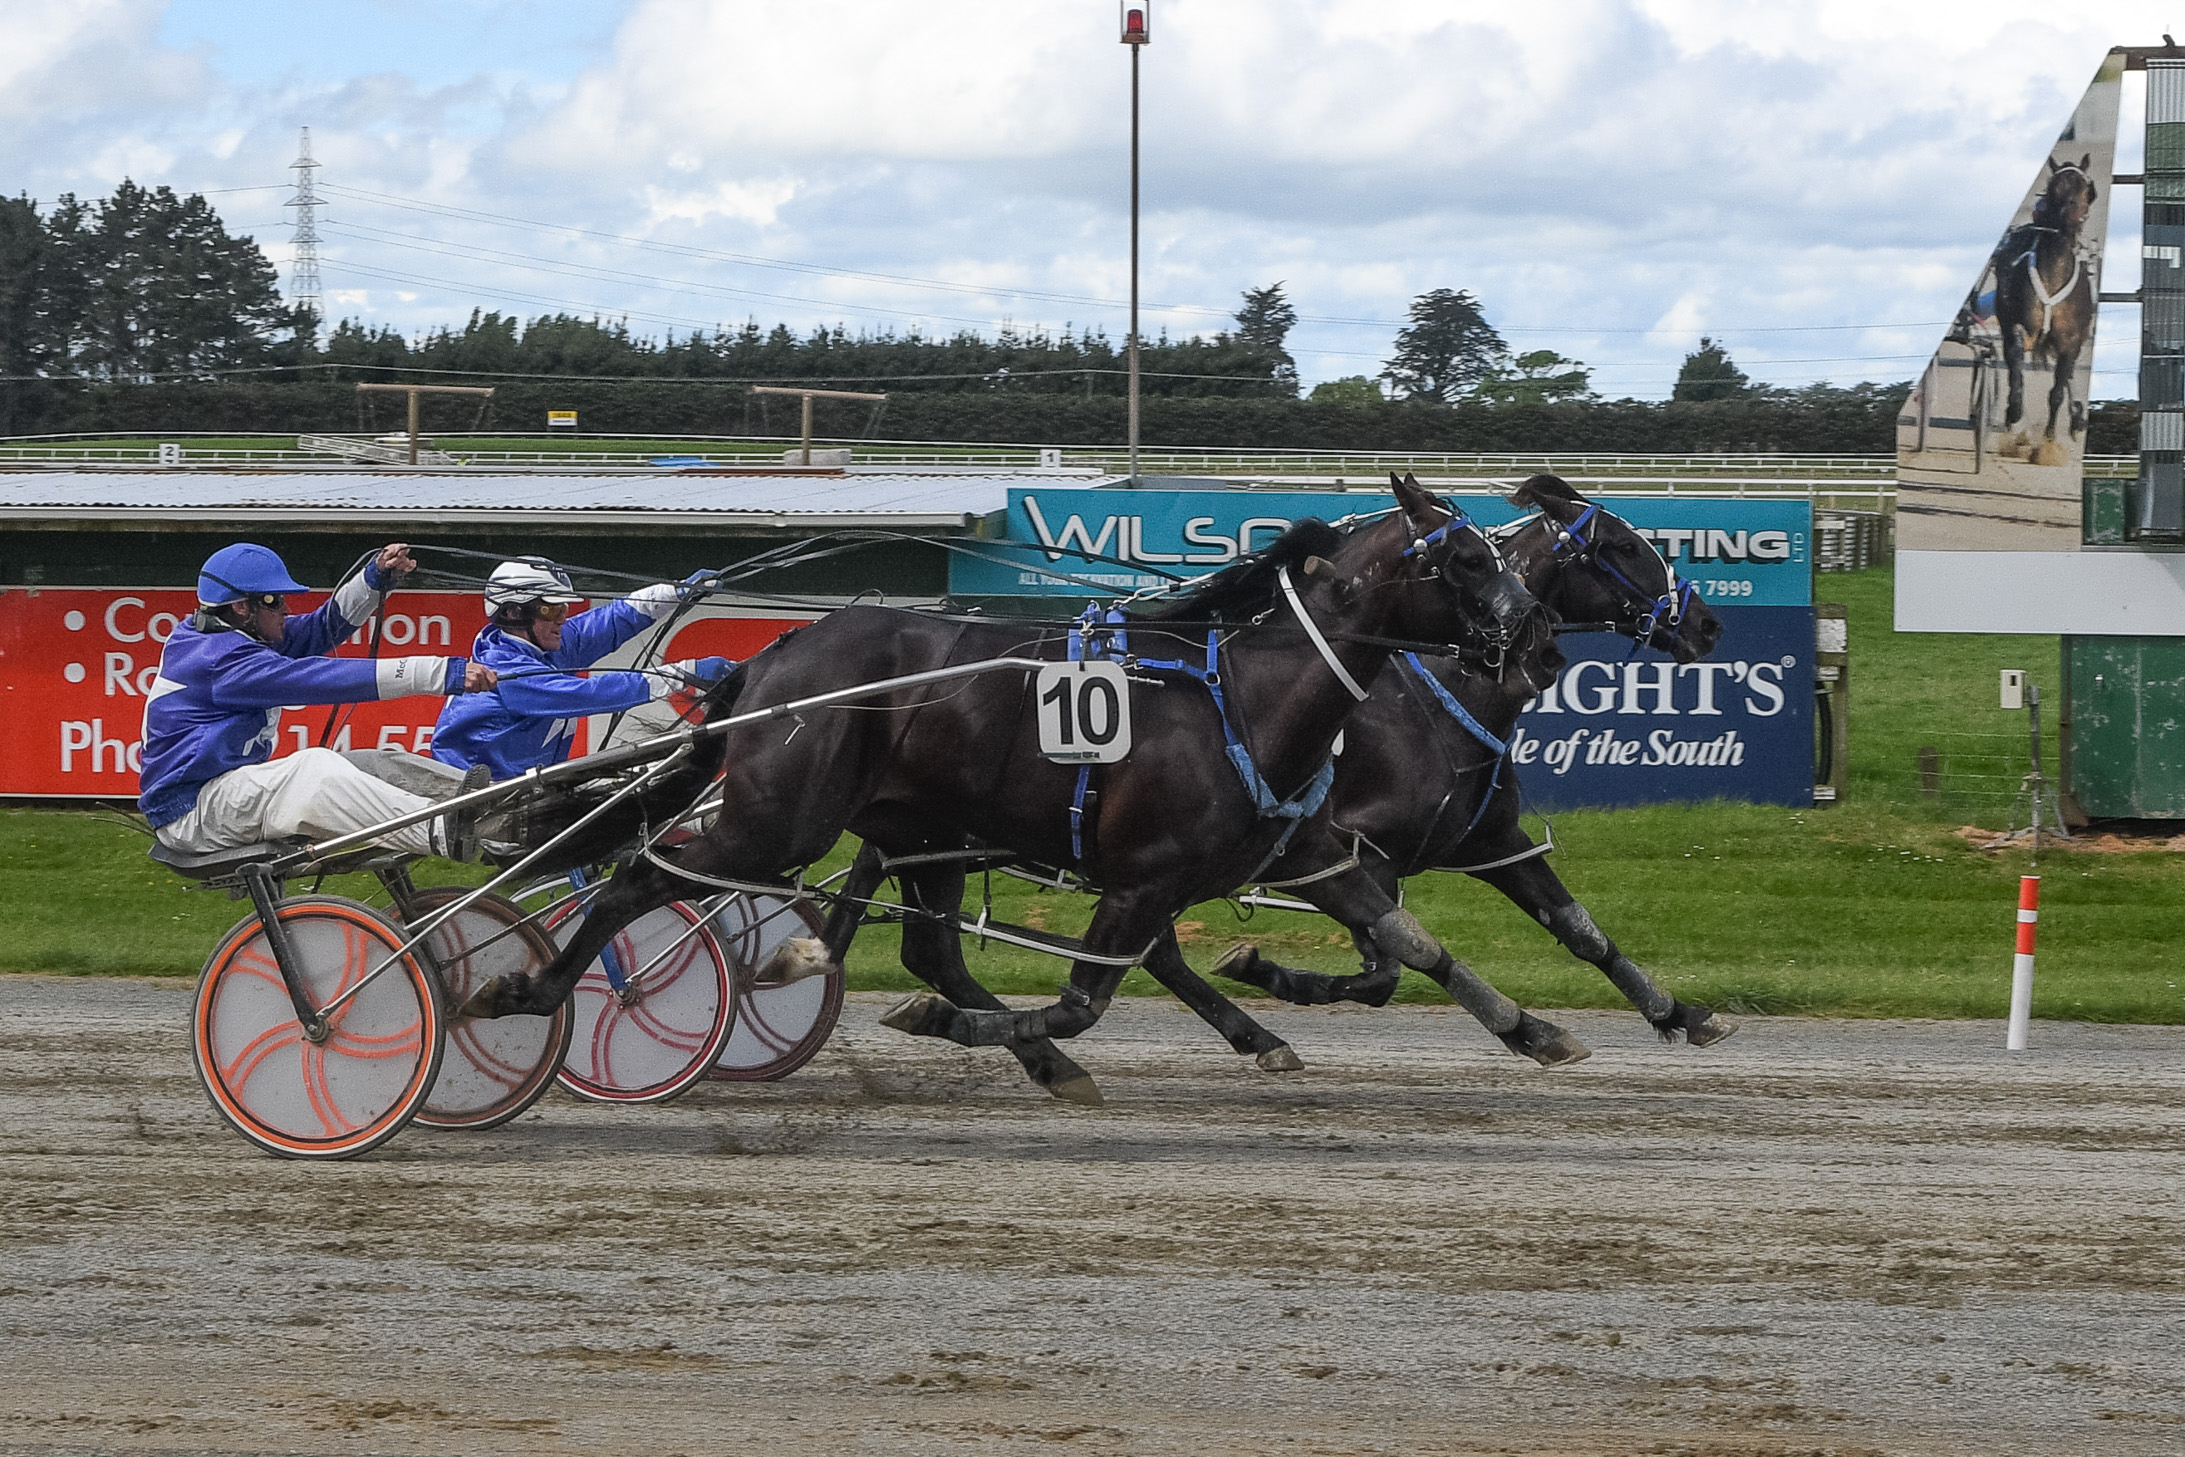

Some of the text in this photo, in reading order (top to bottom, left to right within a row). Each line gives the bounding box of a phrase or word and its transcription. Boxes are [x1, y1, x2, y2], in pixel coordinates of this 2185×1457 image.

[164, 445, 175, 457] 2
[1046, 452, 1054, 463] 1
[1636, 528, 1791, 563] TING
[1704, 579, 1754, 597] 7999
[1521, 660, 1785, 716] IGHT'S
[1042, 676, 1120, 746] 10
[1543, 728, 1591, 776] of
[1585, 728, 1641, 766] the
[1640, 728, 1746, 767] South
